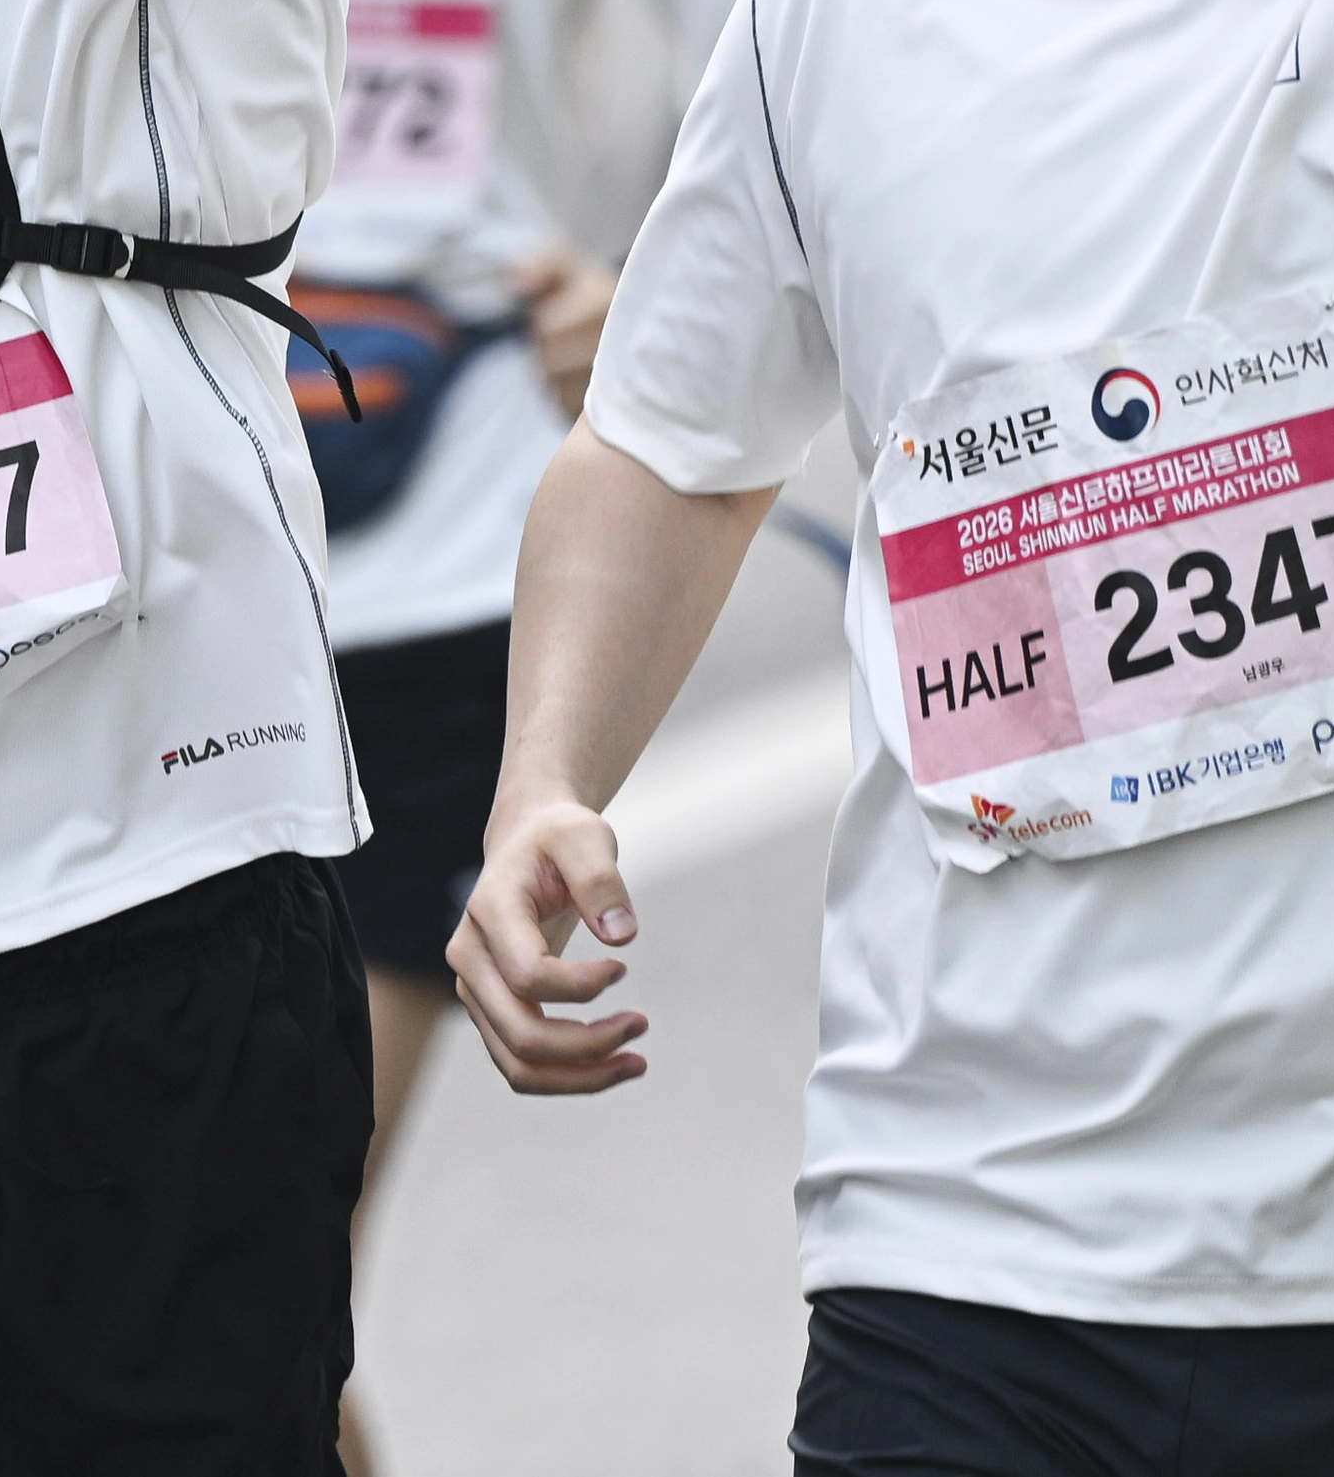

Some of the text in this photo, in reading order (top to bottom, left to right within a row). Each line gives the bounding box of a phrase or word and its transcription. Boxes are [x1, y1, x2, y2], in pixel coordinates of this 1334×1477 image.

[1175, 338, 1330, 406] 인사혁신처
[919, 405, 1058, 484] 서울신문
[957, 427, 1292, 549] 2026 서울신문하프마라톤대회
[962, 461, 1300, 576] SEOUL SHINMUN HALF MARATHON
[916, 631, 1047, 719] HALF
[161, 723, 306, 774] FILA RUNNING
[1147, 737, 1285, 796] IBK 기업은행
[1008, 809, 1093, 842] telecom
